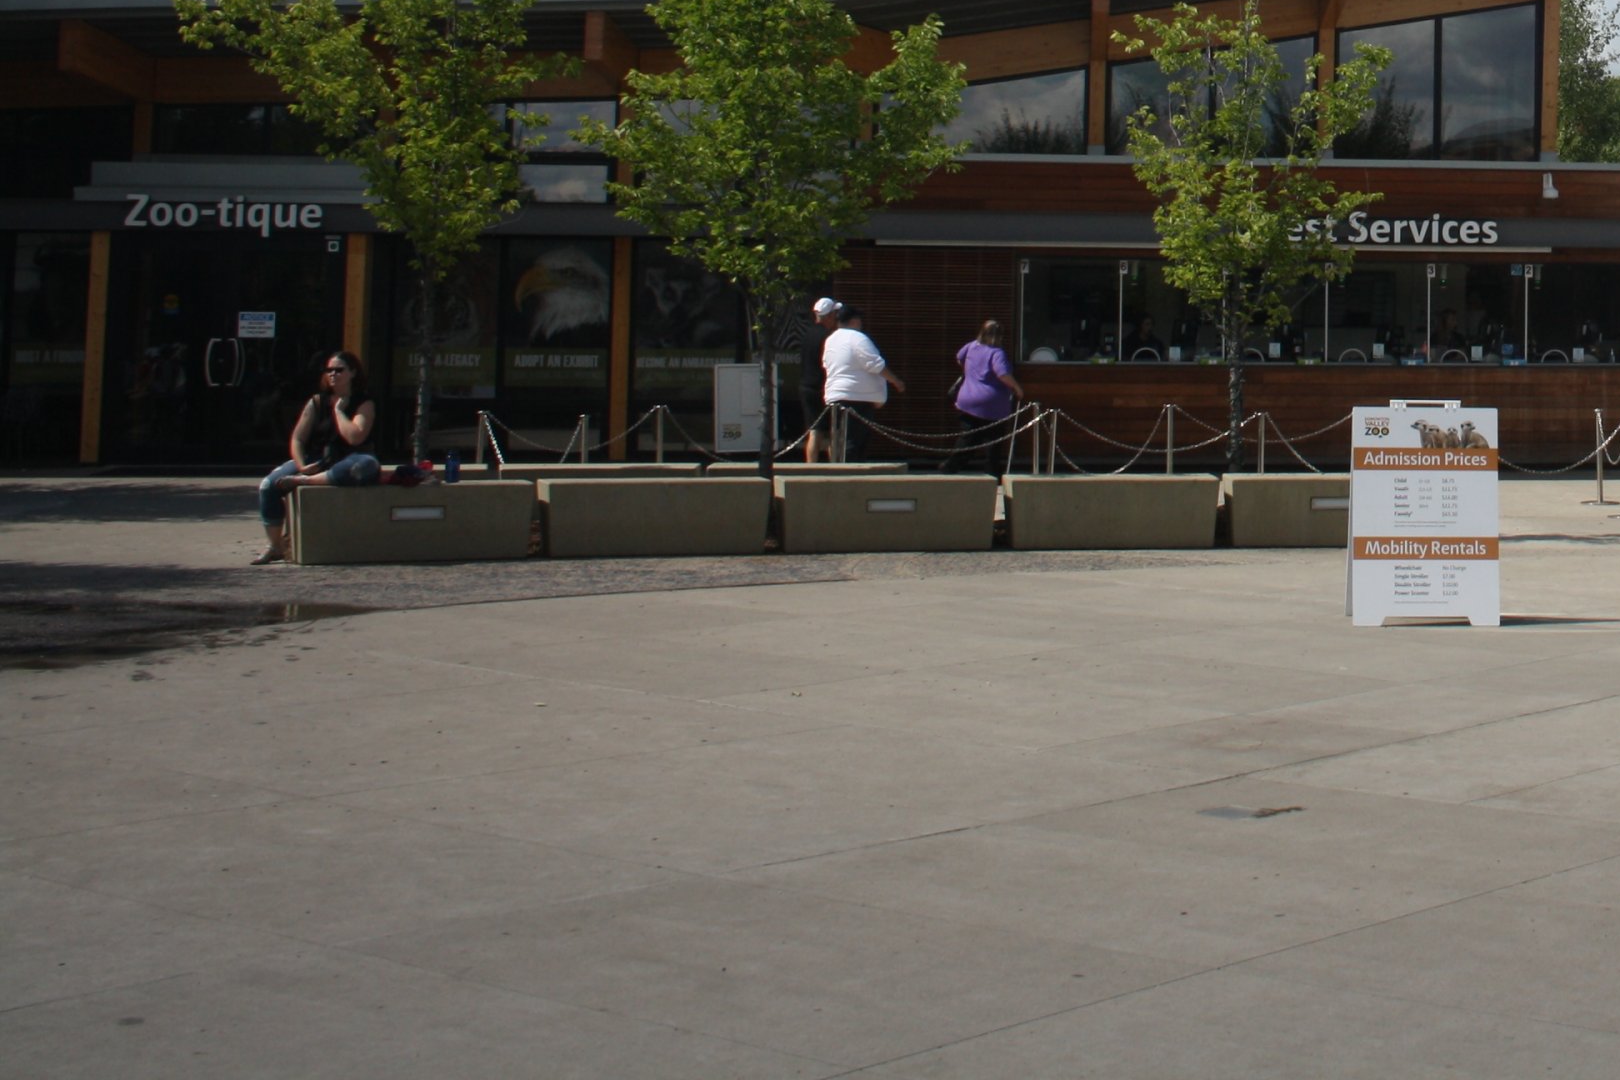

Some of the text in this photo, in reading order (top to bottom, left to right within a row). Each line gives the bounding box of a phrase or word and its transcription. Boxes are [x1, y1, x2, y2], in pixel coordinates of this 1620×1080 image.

[124, 193, 323, 238] Zoo-tique
[1348, 211, 1499, 244] Services
[444, 353, 481, 367] LEGACY
[514, 354, 599, 368] ADOPT AN EXHIBIT
[636, 357, 666, 368] BECOME
[669, 357, 681, 368] AN
[1365, 427, 1389, 436] ZOO
[1363, 451, 1488, 466] Admission Prices
[1365, 540, 1487, 559] Mobility Rentals
